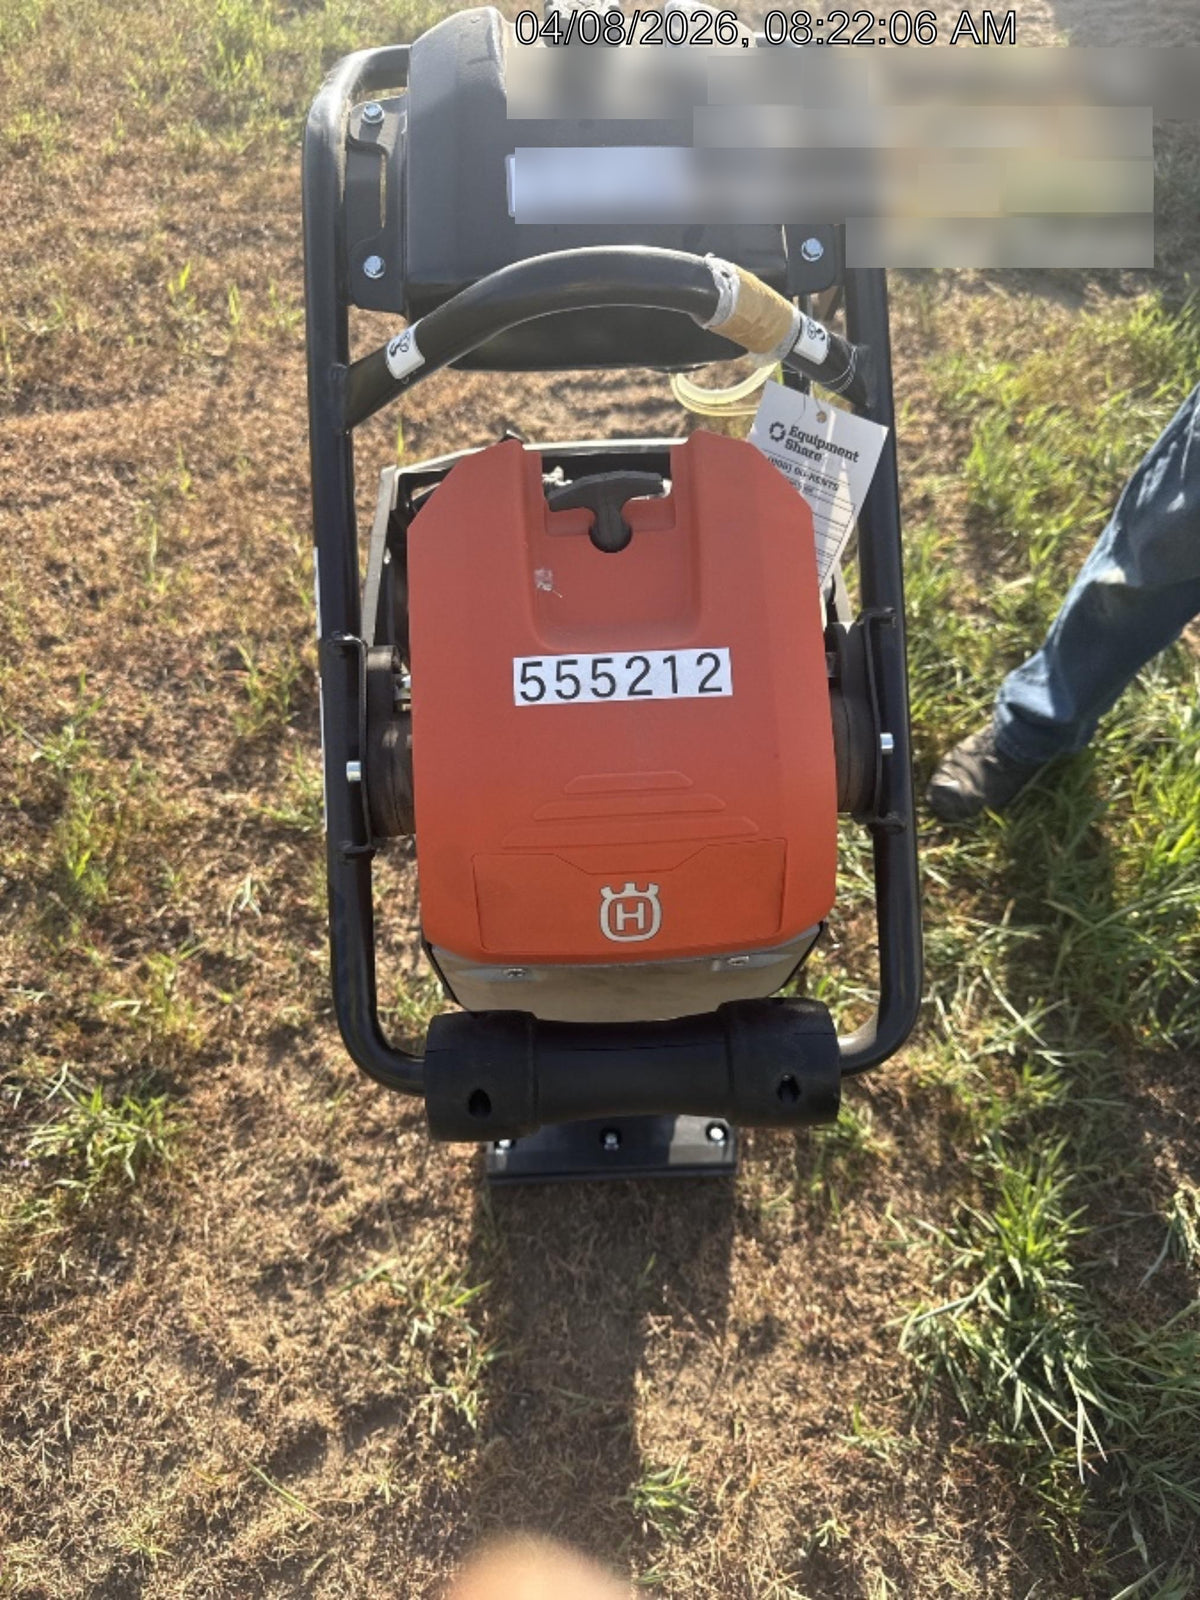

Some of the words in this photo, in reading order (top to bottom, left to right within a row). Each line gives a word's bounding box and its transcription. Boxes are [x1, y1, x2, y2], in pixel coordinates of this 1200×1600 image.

[784, 438, 823, 462] Share
[788, 426, 859, 463] Equipment
[519, 651, 723, 703] 555212
